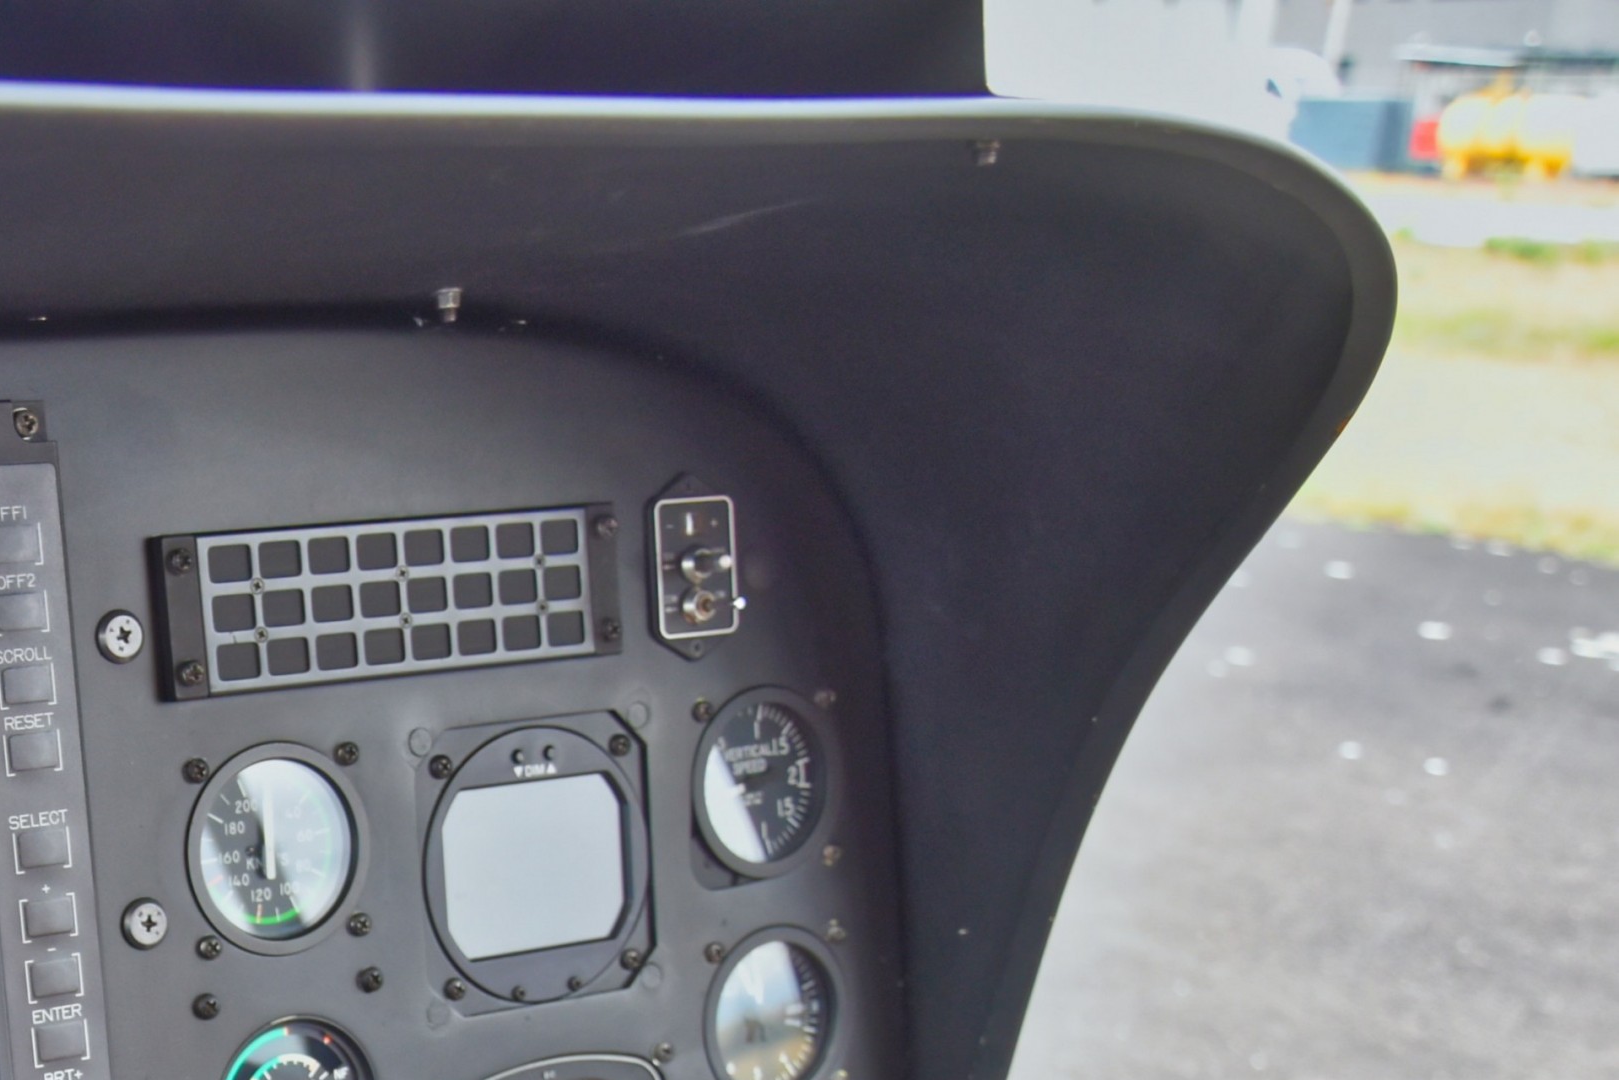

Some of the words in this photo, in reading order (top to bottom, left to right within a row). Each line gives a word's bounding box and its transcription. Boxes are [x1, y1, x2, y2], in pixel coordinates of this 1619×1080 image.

[4, 713, 54, 731] RESET
[235, 800, 258, 815] 200
[8, 810, 68, 830] SELECT
[224, 821, 245, 836] 180
[220, 850, 240, 864] 160
[229, 873, 250, 887] 140
[251, 887, 272, 902] 120
[32, 1004, 82, 1025] ENTER
